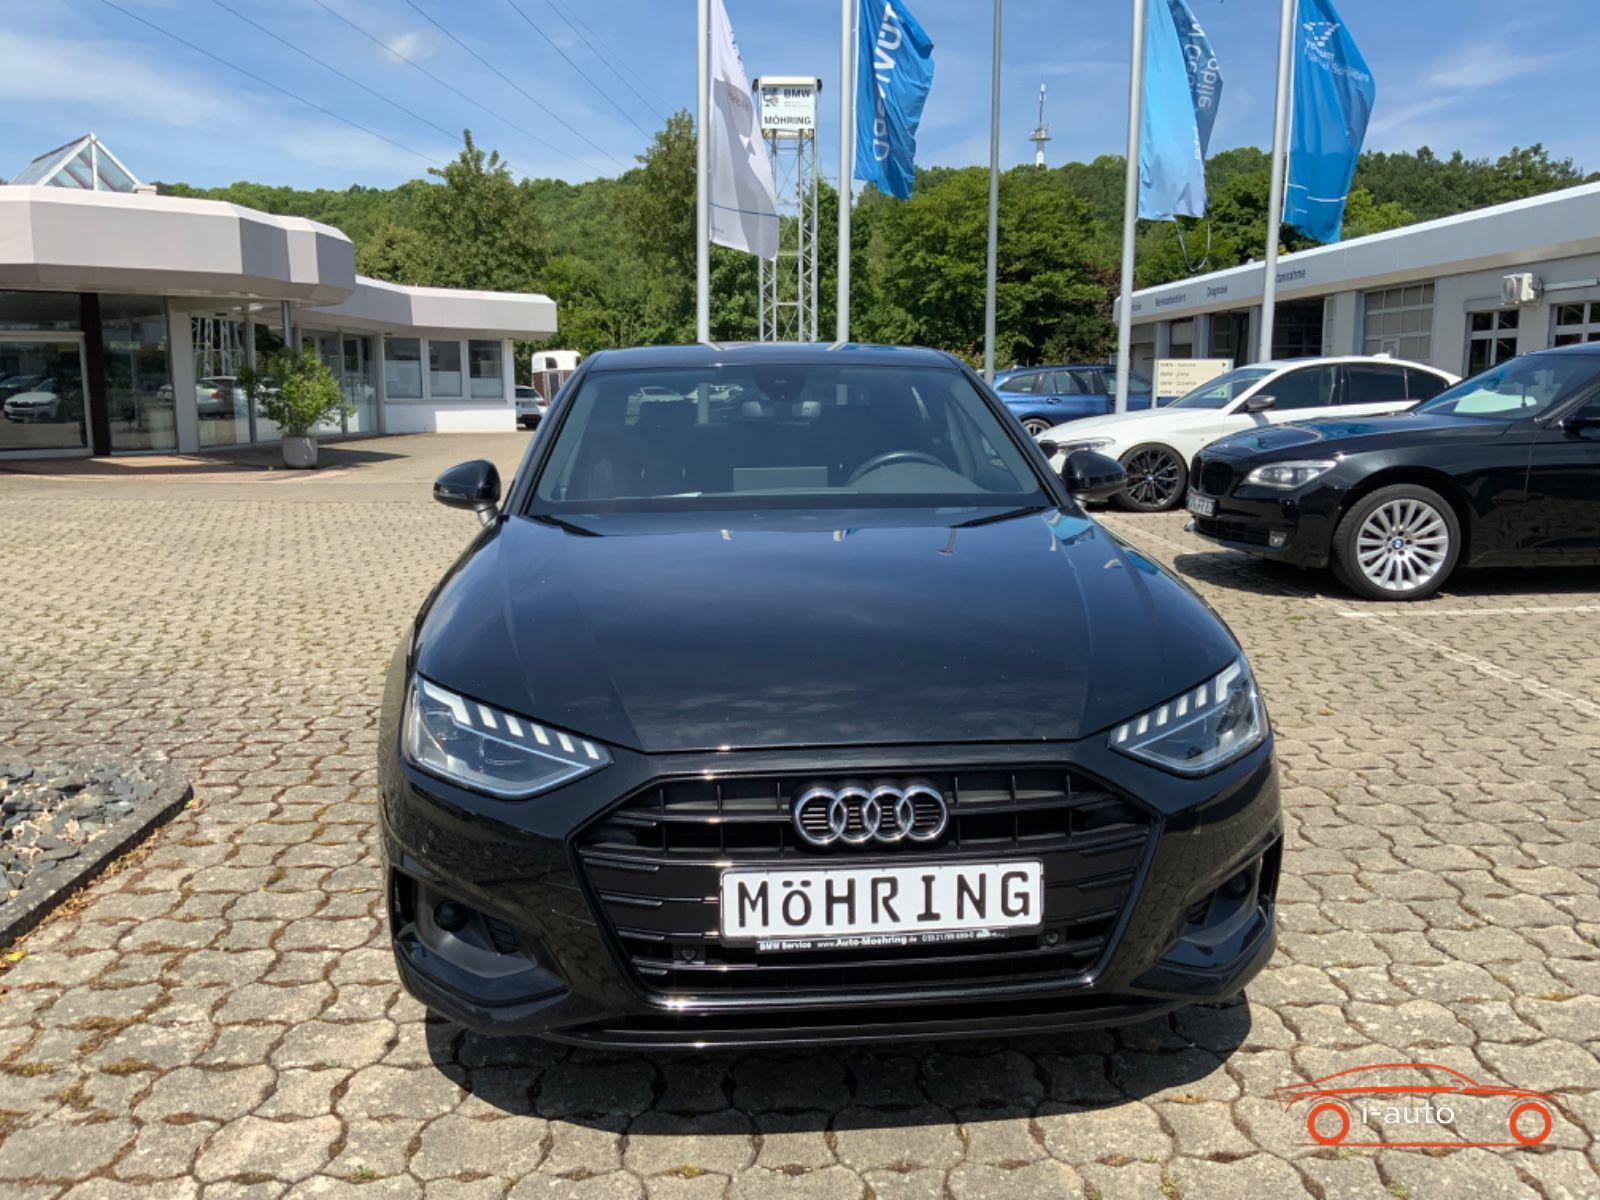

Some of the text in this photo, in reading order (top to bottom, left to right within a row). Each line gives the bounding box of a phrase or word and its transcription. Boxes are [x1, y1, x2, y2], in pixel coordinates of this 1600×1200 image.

[783, 88, 812, 98] BMW
[764, 114, 811, 125] MÖHRING
[760, 941, 780, 950] BMW
[782, 940, 812, 949] Service
